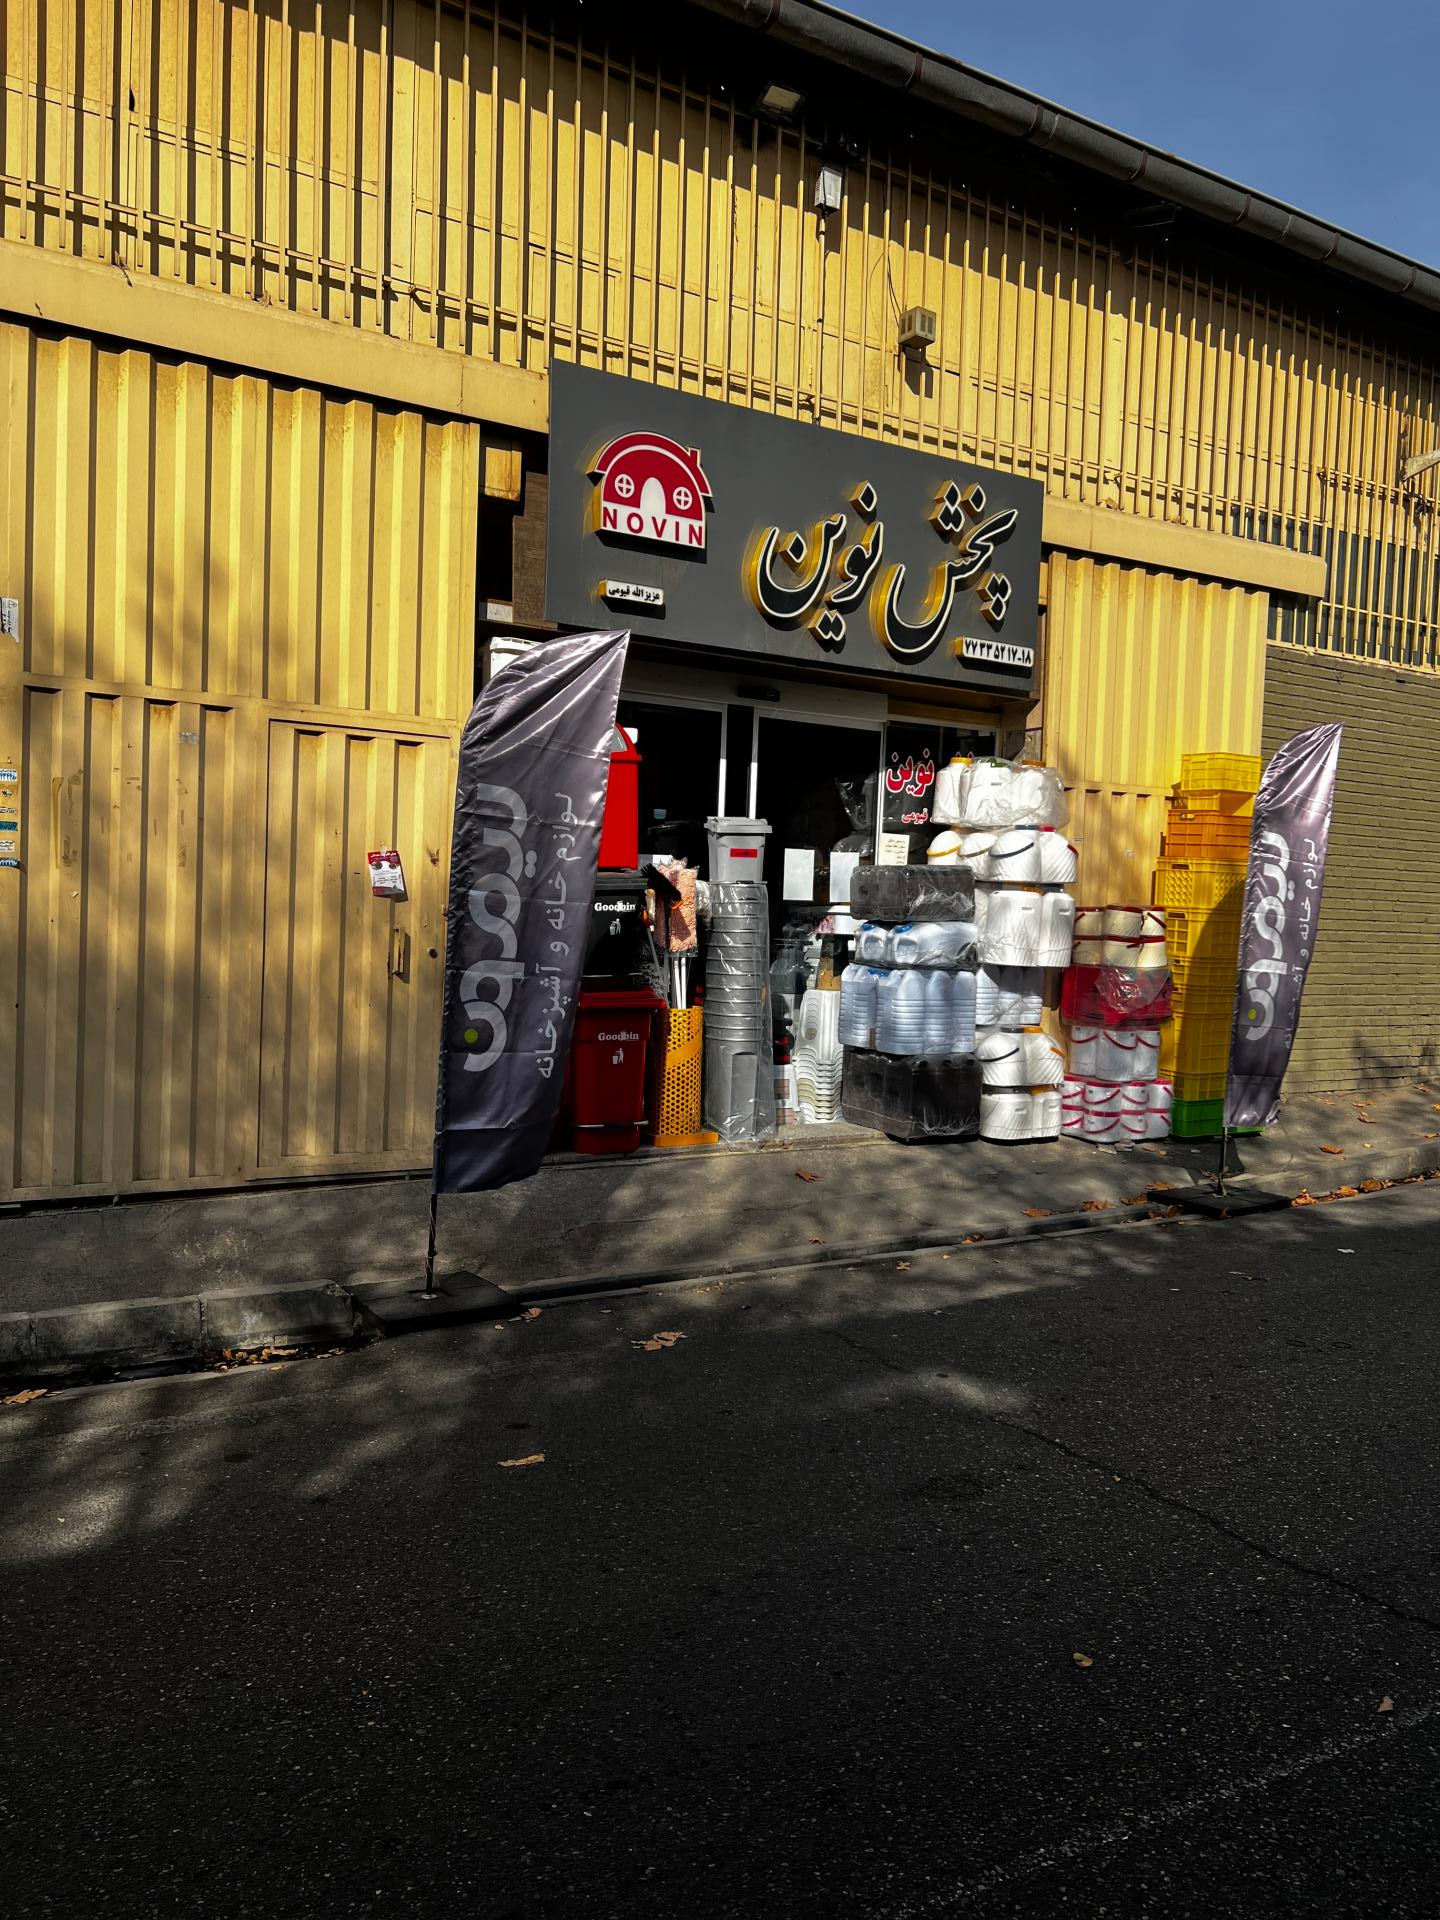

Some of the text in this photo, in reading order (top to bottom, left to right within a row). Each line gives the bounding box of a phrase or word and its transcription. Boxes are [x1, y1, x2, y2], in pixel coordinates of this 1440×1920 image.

[602, 506, 704, 548] NOVIN
[608, 585, 630, 598] قیومی
[755, 478, 1019, 655] پخش نوین
[886, 747, 935, 797] نوین
[901, 807, 929, 825] قیومی
[1303, 838, 1318, 890] لوازم
[458, 782, 538, 1073] لیمون
[535, 792, 582, 1079] لوازم خانه و آشپزخانه
[1242, 830, 1296, 1041] لیمون
[1298, 896, 1312, 941] خانه
[1300, 948, 1310, 959] و
